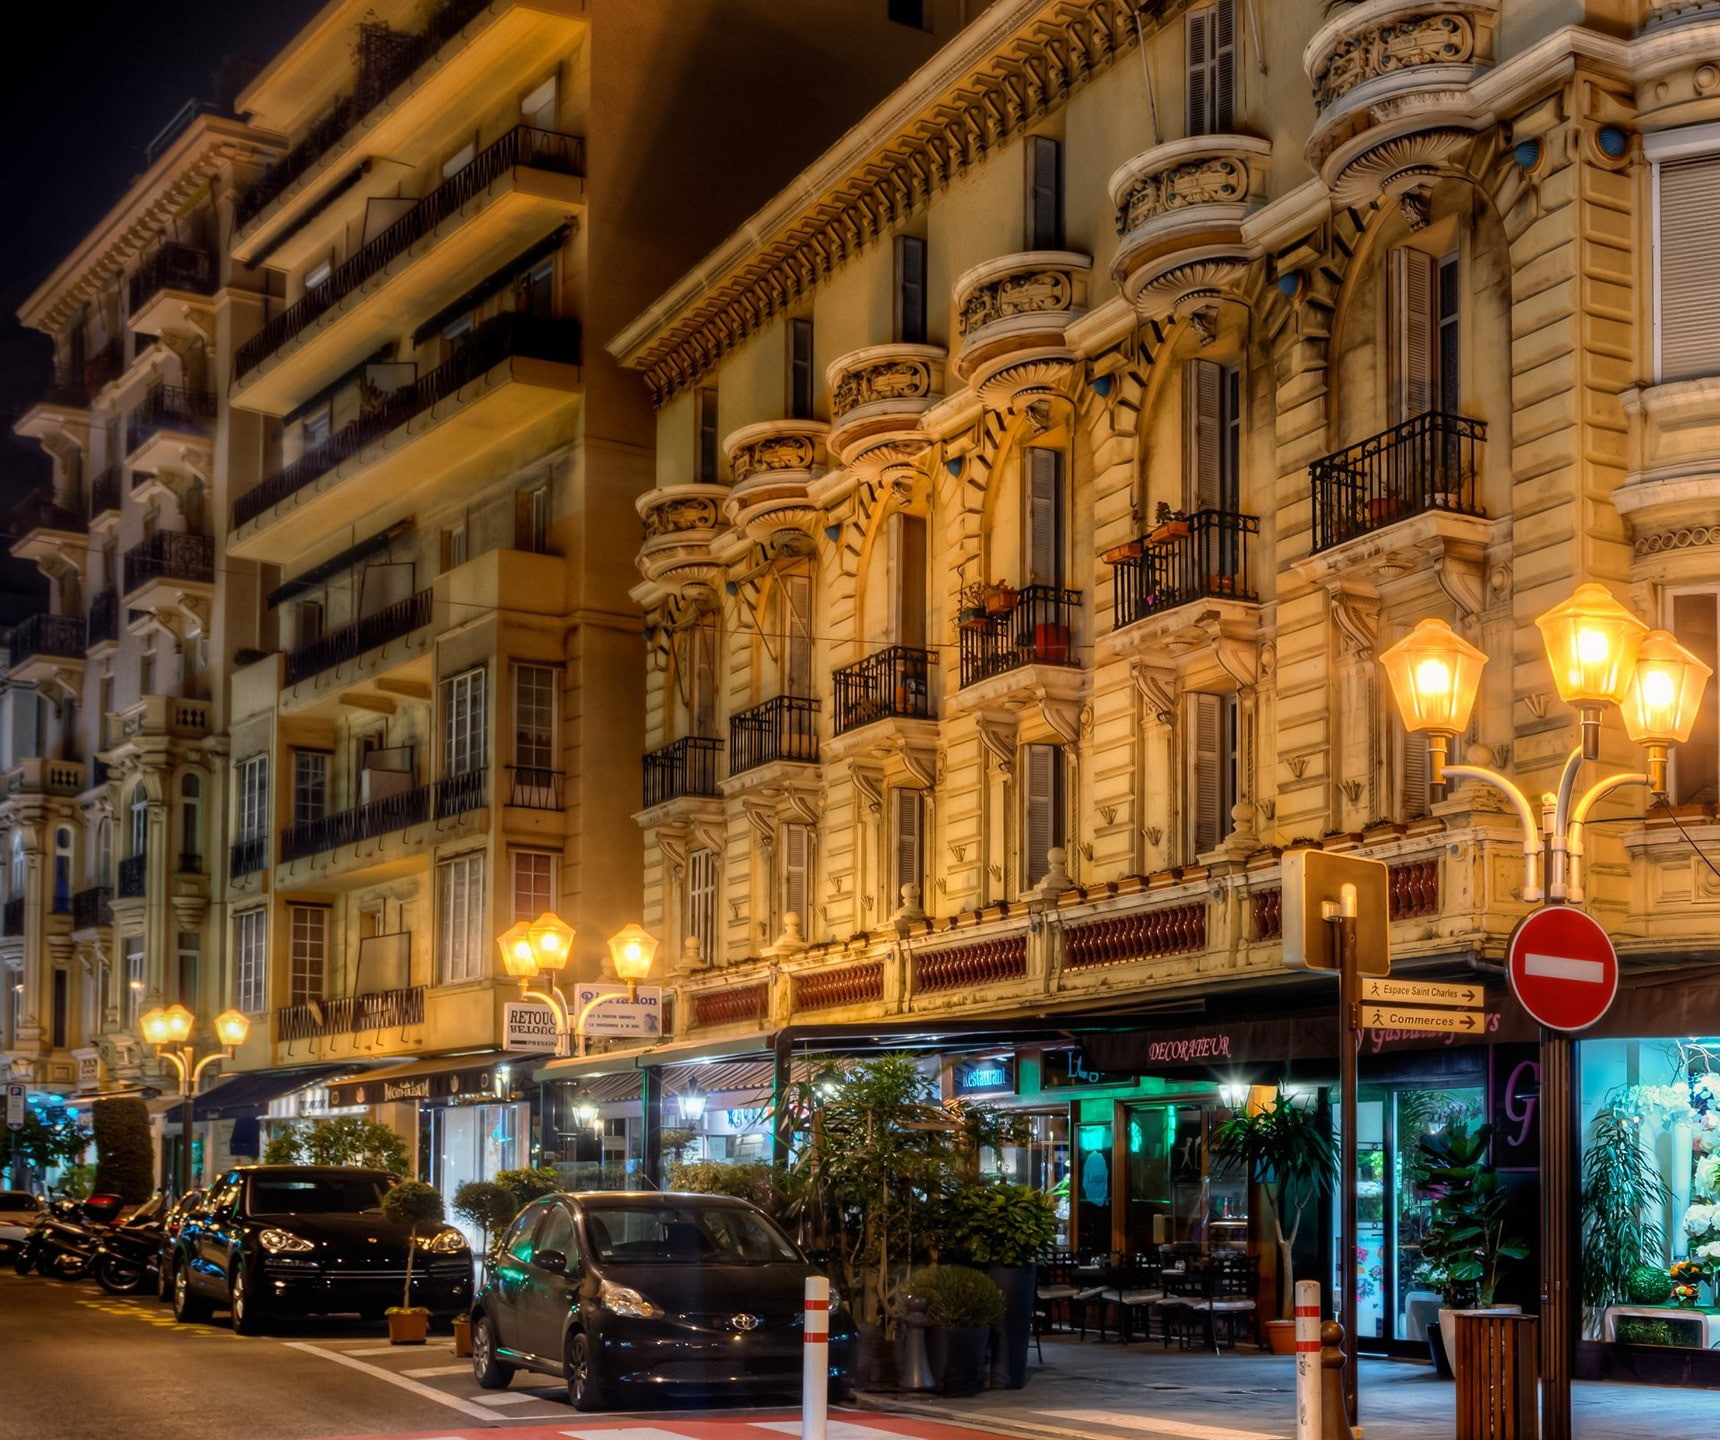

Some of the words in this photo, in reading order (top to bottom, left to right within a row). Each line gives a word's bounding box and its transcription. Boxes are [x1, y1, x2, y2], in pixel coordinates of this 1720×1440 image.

[1383, 984, 1410, 996] Espace
[1411, 986, 1430, 997] Saint
[1431, 987, 1458, 999] Charles
[1389, 1013, 1454, 1027] Commerces
[1148, 1034, 1232, 1062] DECORATEUR
[963, 1067, 1006, 1088] Restaurant
